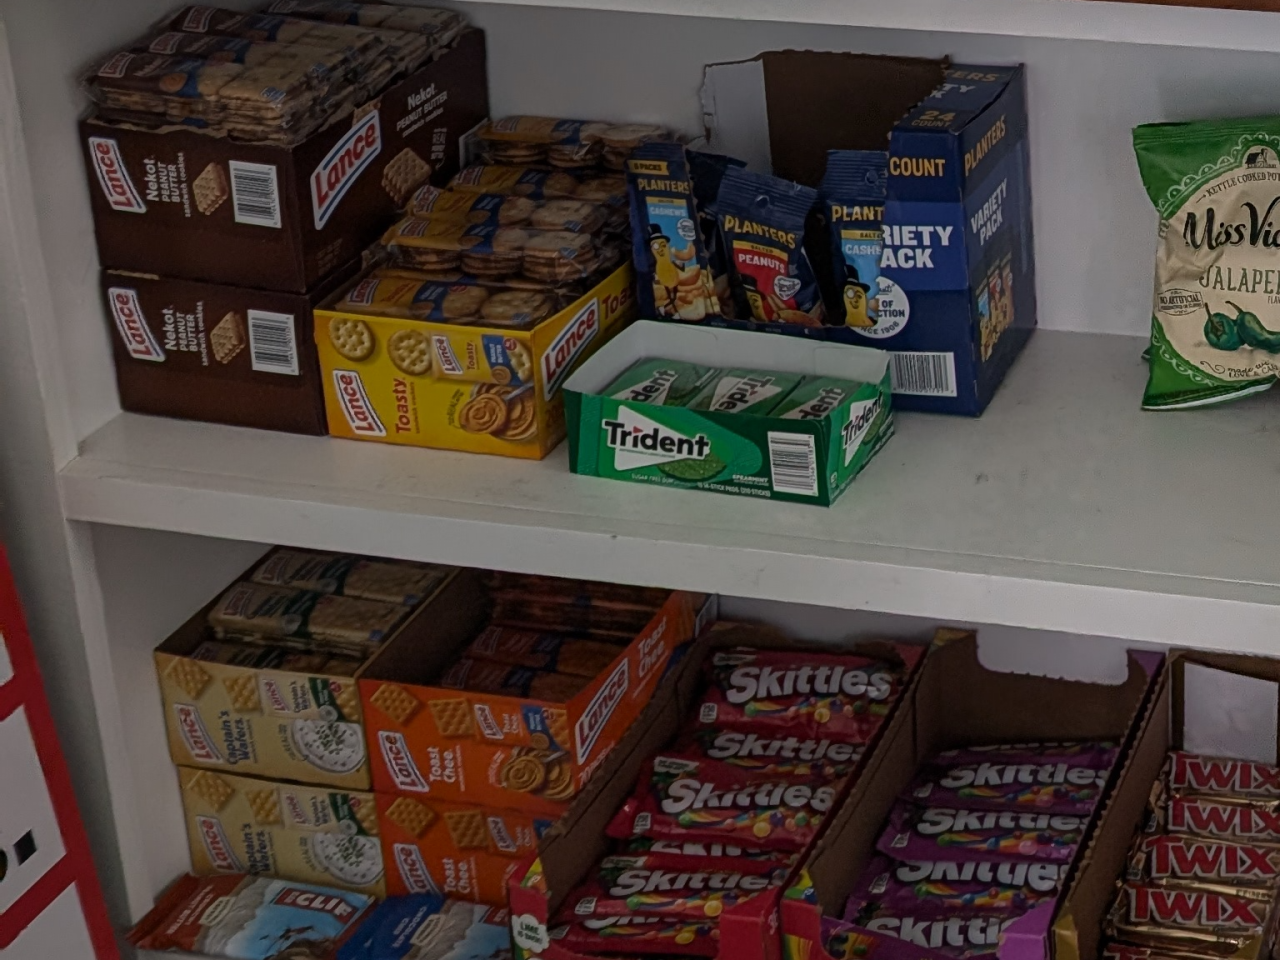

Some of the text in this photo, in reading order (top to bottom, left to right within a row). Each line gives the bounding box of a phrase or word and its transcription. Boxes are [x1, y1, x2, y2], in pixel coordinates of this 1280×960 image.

[396, 91, 448, 132] PEANUT BUTTER
[406, 82, 436, 110] Nekot
[920, 110, 953, 121] 24
[911, 119, 952, 128] COUNT
[964, 114, 1006, 176] PLANTERS
[99, 140, 135, 209] Lance
[146, 155, 160, 202] Nekot
[157, 161, 171, 203] PEANUT
[167, 164, 182, 203] BUTTER
[314, 122, 377, 211] Lance
[638, 178, 690, 194] PLANTERS
[889, 157, 945, 177] COUNT
[1206, 177, 1237, 197] KETTLE
[1237, 173, 1266, 184] COOKED
[650, 206, 687, 217] CASHEWS
[832, 205, 884, 222] PLANT
[970, 178, 1008, 234] VARIETY
[724, 214, 797, 250] PLANTERS
[881, 226, 953, 246] RIETY
[979, 206, 1003, 246] PACK
[1183, 207, 1246, 250] Miss
[738, 253, 785, 274] PEANUTS
[881, 249, 934, 268] ACK
[116, 292, 152, 356] Lance
[882, 300, 894, 309] OF
[162, 308, 178, 351] Nekot
[176, 311, 189, 352] PEANUT
[186, 314, 199, 352] BUTTER
[544, 307, 597, 382] Lance
[340, 373, 375, 432] Lance
[393, 378, 411, 434] Toasty
[842, 391, 882, 446] Trident
[604, 419, 709, 458] Trident
[732, 474, 769, 483] SPEARMINT
[638, 617, 668, 656] Toast
[638, 639, 665, 678] Chee
[725, 665, 893, 705] Skittles
[578, 667, 628, 752] Lance
[179, 707, 214, 761] Lance
[219, 711, 239, 765] Captain's
[234, 718, 250, 761] Wafers
[384, 734, 418, 788] Lance
[427, 745, 443, 782] Toast
[442, 748, 457, 784] Chee
[661, 778, 836, 814] Skittles
[202, 818, 235, 871] Lance
[1146, 835, 1277, 876] TWIX
[442, 857, 457, 892] Toast
[458, 860, 471, 894] Chee
[296, 893, 353, 917] CLIF
[1125, 882, 1260, 925] TWIX
